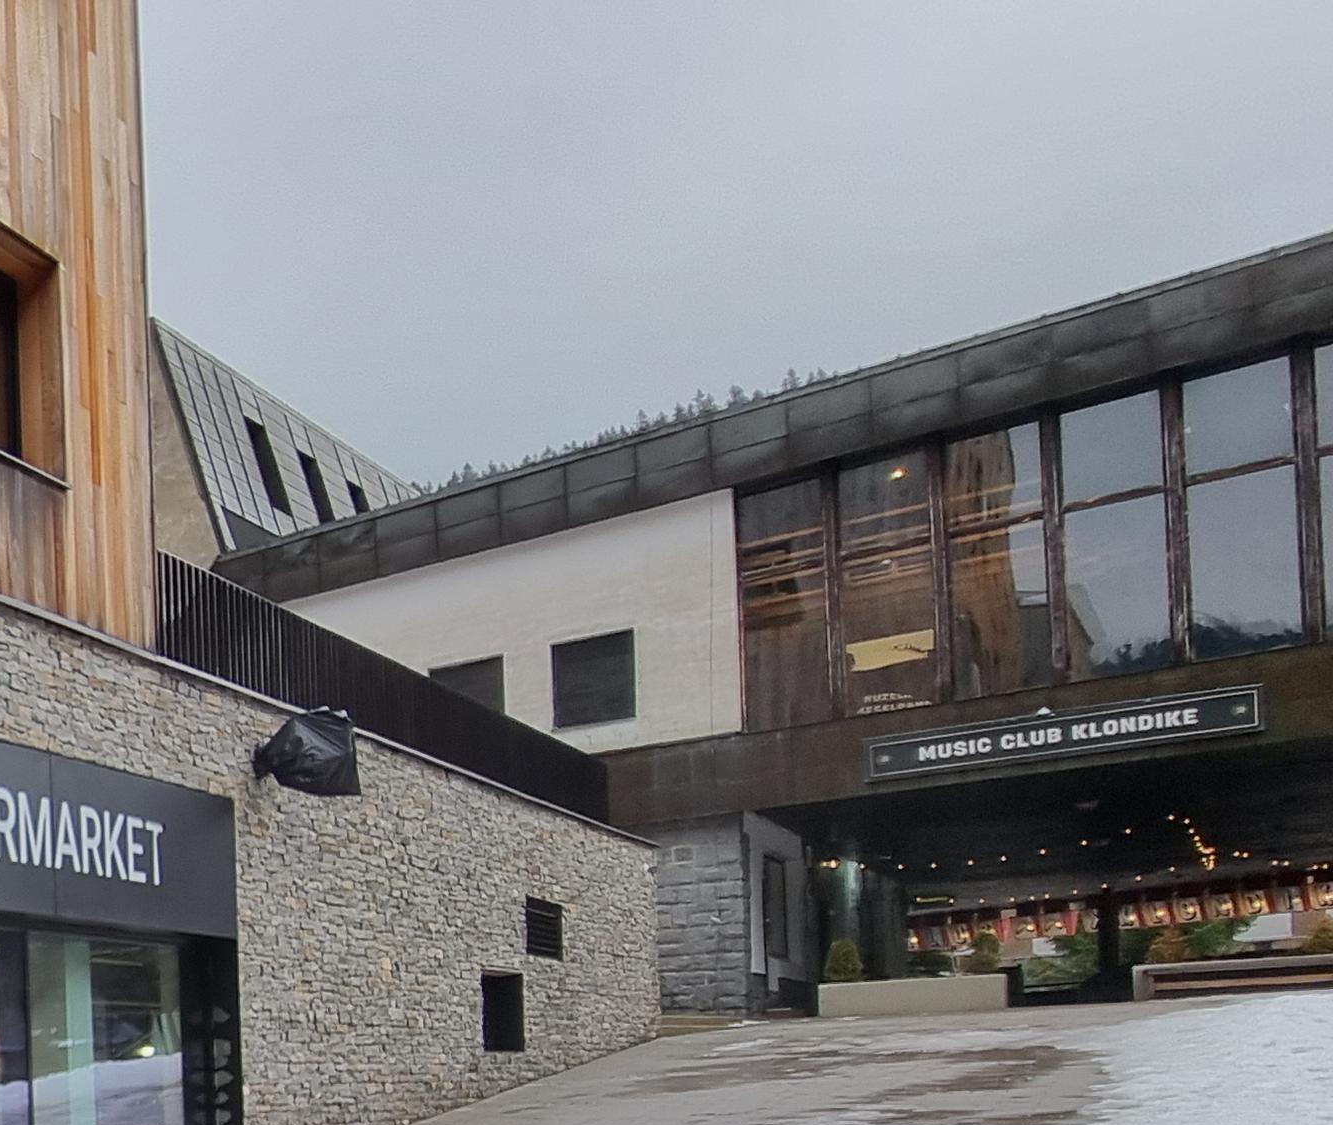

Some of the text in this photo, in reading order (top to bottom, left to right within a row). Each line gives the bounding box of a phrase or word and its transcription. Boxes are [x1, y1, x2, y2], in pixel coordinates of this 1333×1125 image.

[917, 707, 1200, 762] MUSIC CLUB KLONDIKE
